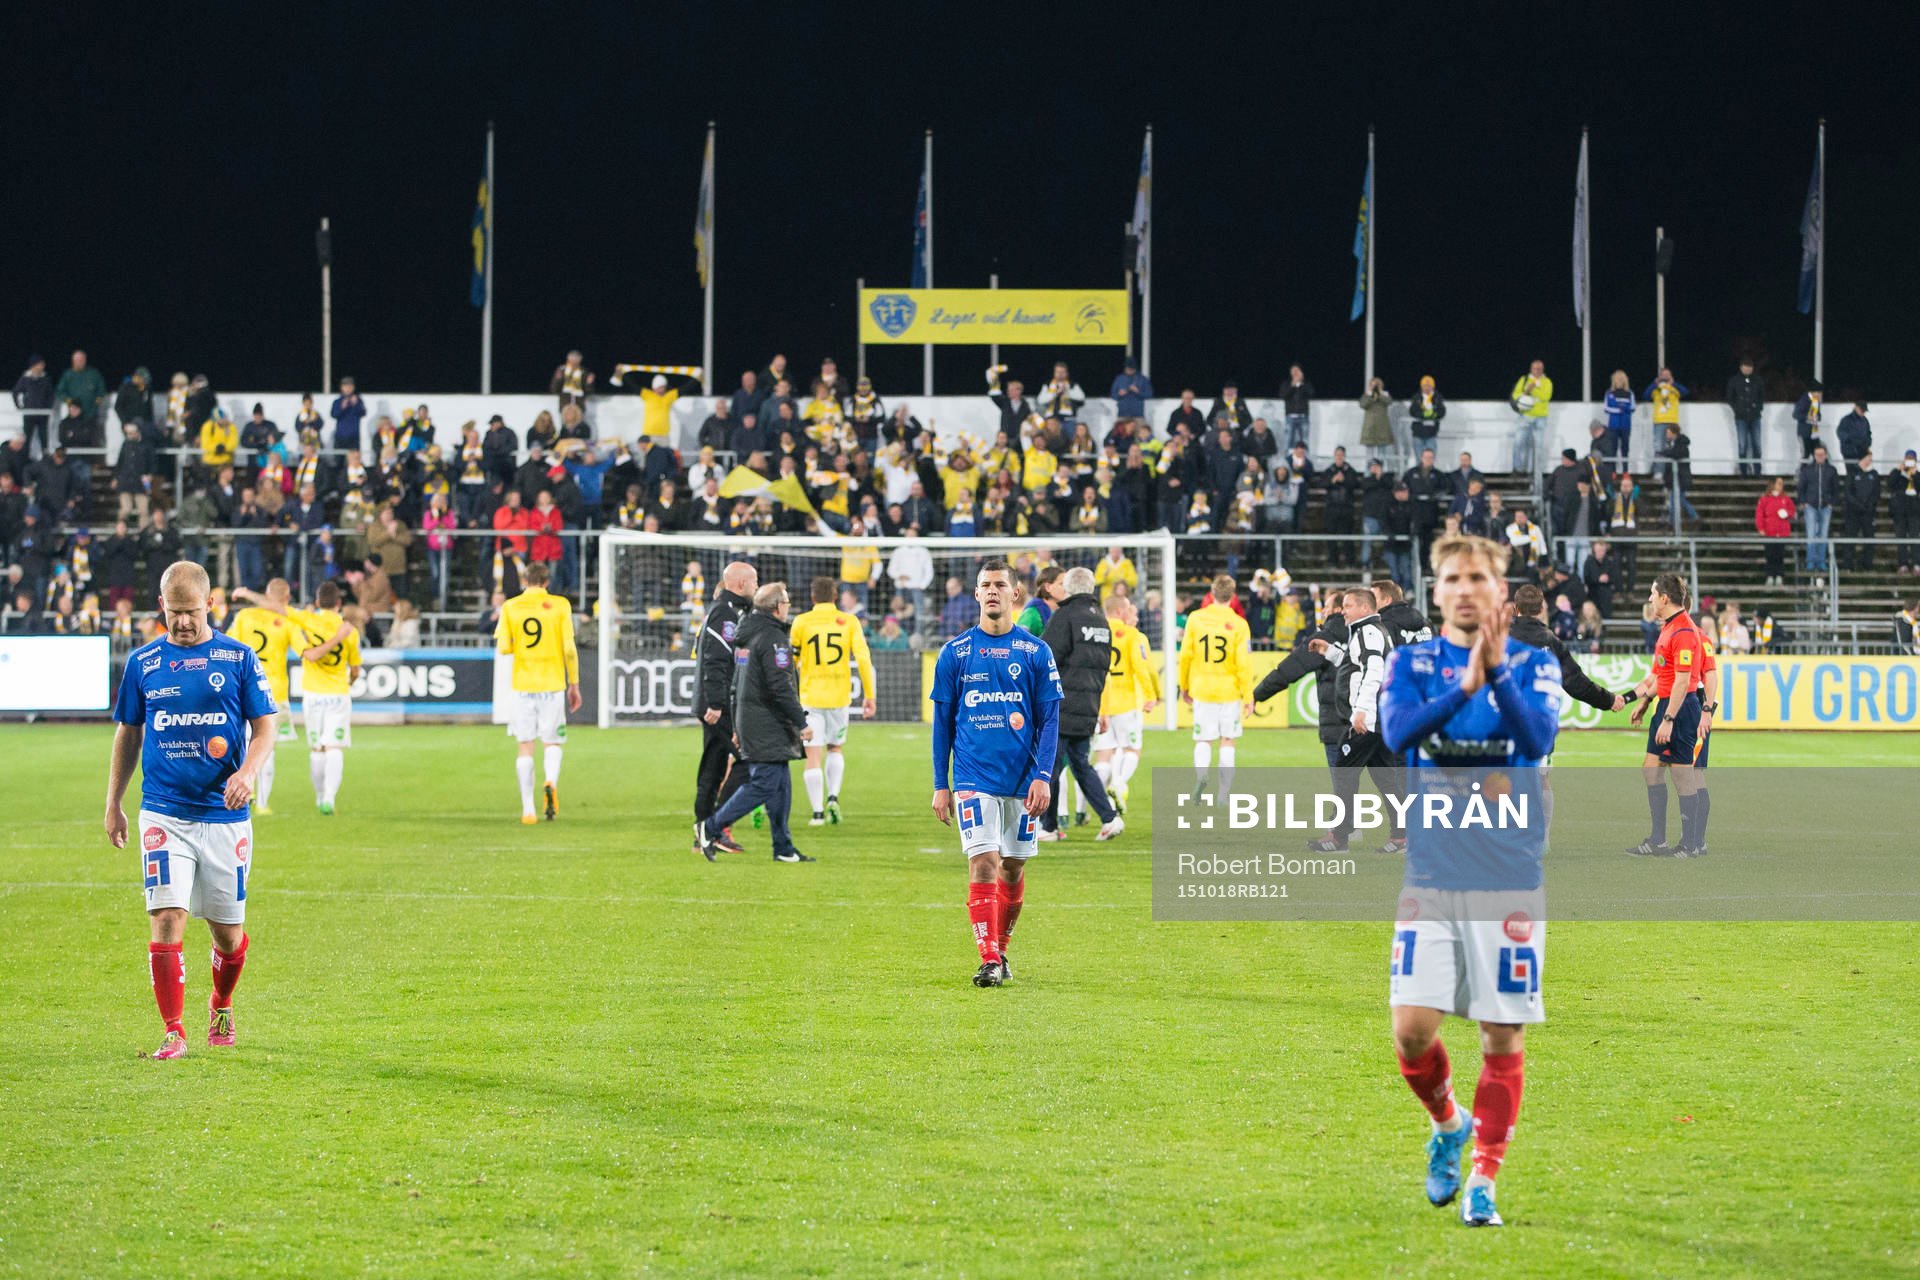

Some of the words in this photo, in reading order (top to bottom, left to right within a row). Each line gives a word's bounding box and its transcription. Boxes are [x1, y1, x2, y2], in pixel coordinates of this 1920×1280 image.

[929, 308, 977, 330] Laget
[523, 617, 542, 648] 9
[807, 632, 843, 666] 15
[1110, 646, 1124, 676] 2
[1199, 634, 1227, 663] 13
[965, 690, 1023, 708] CONRAD
[1722, 663, 1801, 722] ITY
[1812, 663, 1920, 723] GRO
[154, 710, 228, 732] CONRAD
[964, 830, 972, 841] 10
[148, 888, 154, 901] 7
